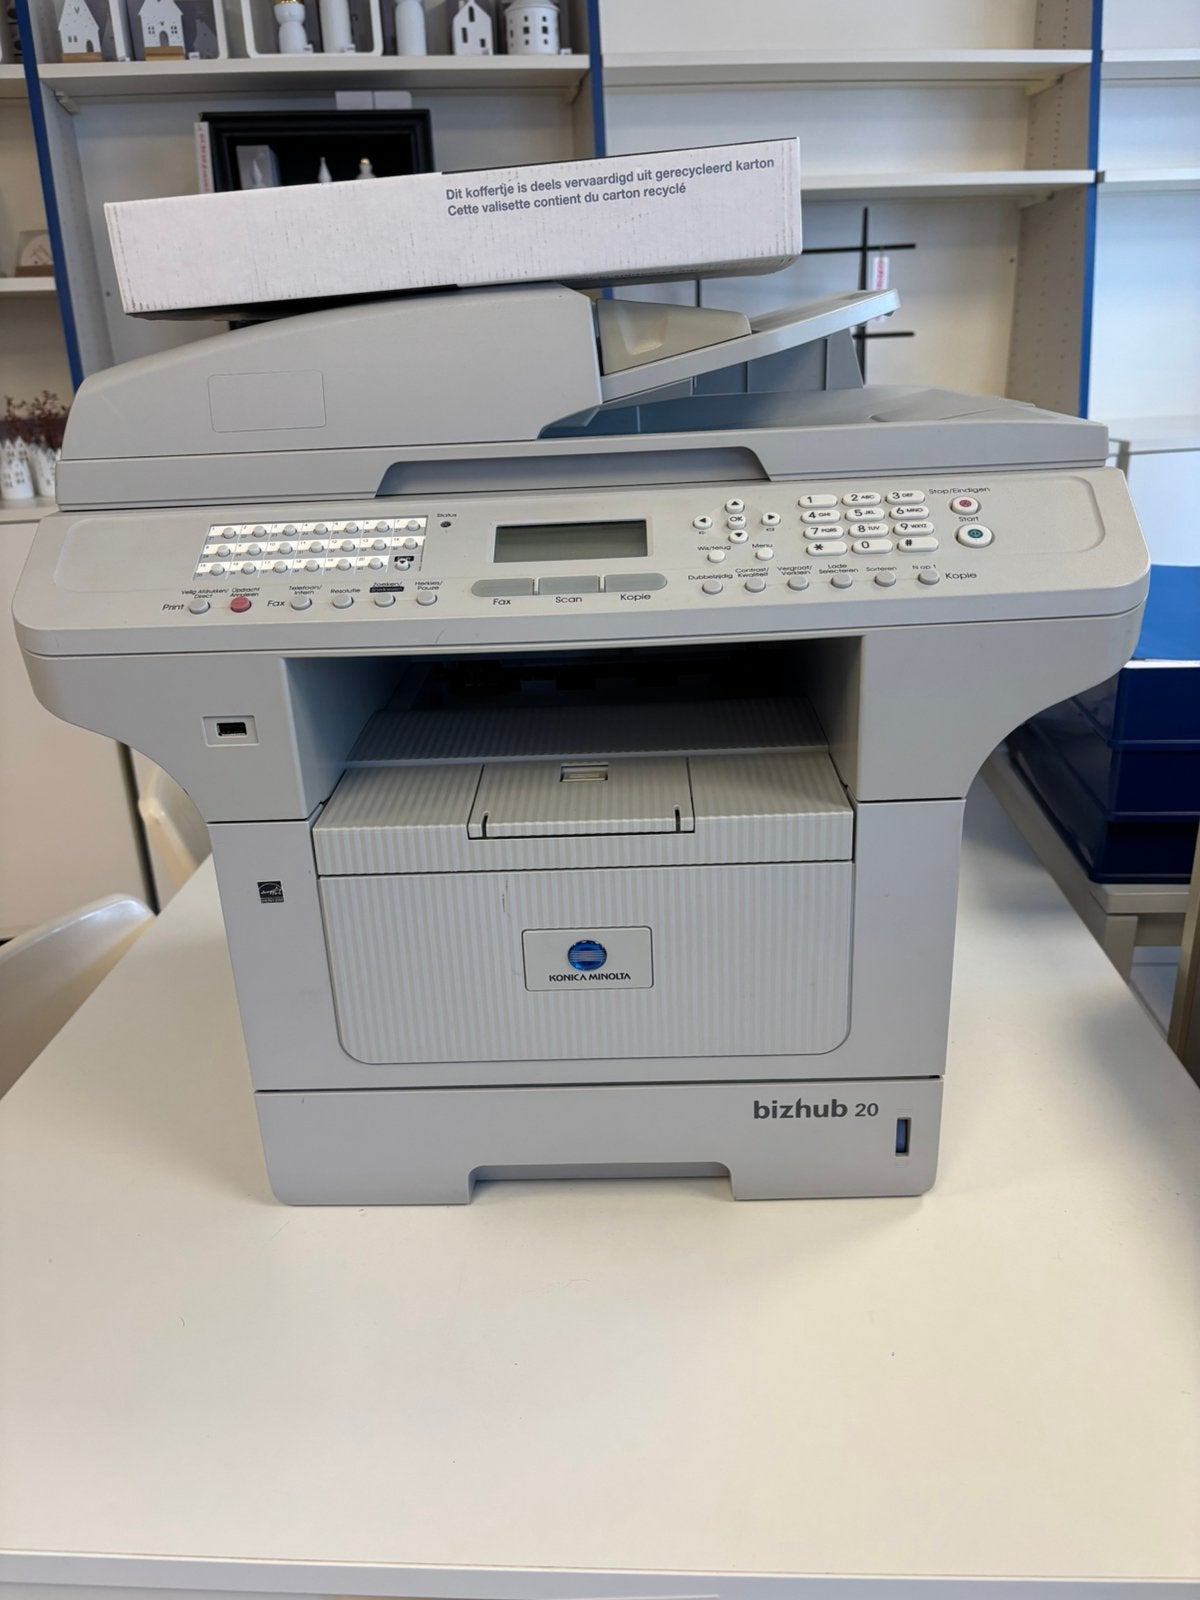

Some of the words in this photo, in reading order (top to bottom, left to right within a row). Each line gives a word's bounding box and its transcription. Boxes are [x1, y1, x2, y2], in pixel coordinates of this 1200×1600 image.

[446, 188, 463, 200] Dit
[466, 184, 515, 198] koffertje
[517, 182, 528, 193] is
[530, 179, 562, 191] deels
[565, 171, 634, 188] vervaardigd
[637, 169, 652, 180] uit
[655, 161, 733, 182] gerecycleerd
[736, 158, 775, 171] karton
[447, 204, 479, 216] Cette
[482, 199, 531, 213] valisette
[533, 193, 582, 208] contient
[584, 191, 599, 203] du
[602, 188, 640, 201] carton
[643, 182, 686, 198] recyclé
[851, 494, 859, 502] 2
[892, 492, 900, 500] 3
[808, 511, 817, 519] 4
[854, 509, 863, 517] 5
[896, 507, 905, 515] 6
[810, 527, 819, 535] 7
[858, 525, 866, 533] 8
[861, 541, 870, 549] 0
[945, 572, 977, 580] Kopie
[555, 596, 583, 604] Scan
[620, 593, 652, 601] Kopie
[162, 603, 184, 611] Print
[549, 973, 587, 982] KONICA
[588, 972, 631, 981] MINOLTA
[753, 1097, 848, 1119] bizhub
[854, 1102, 879, 1117] 20
